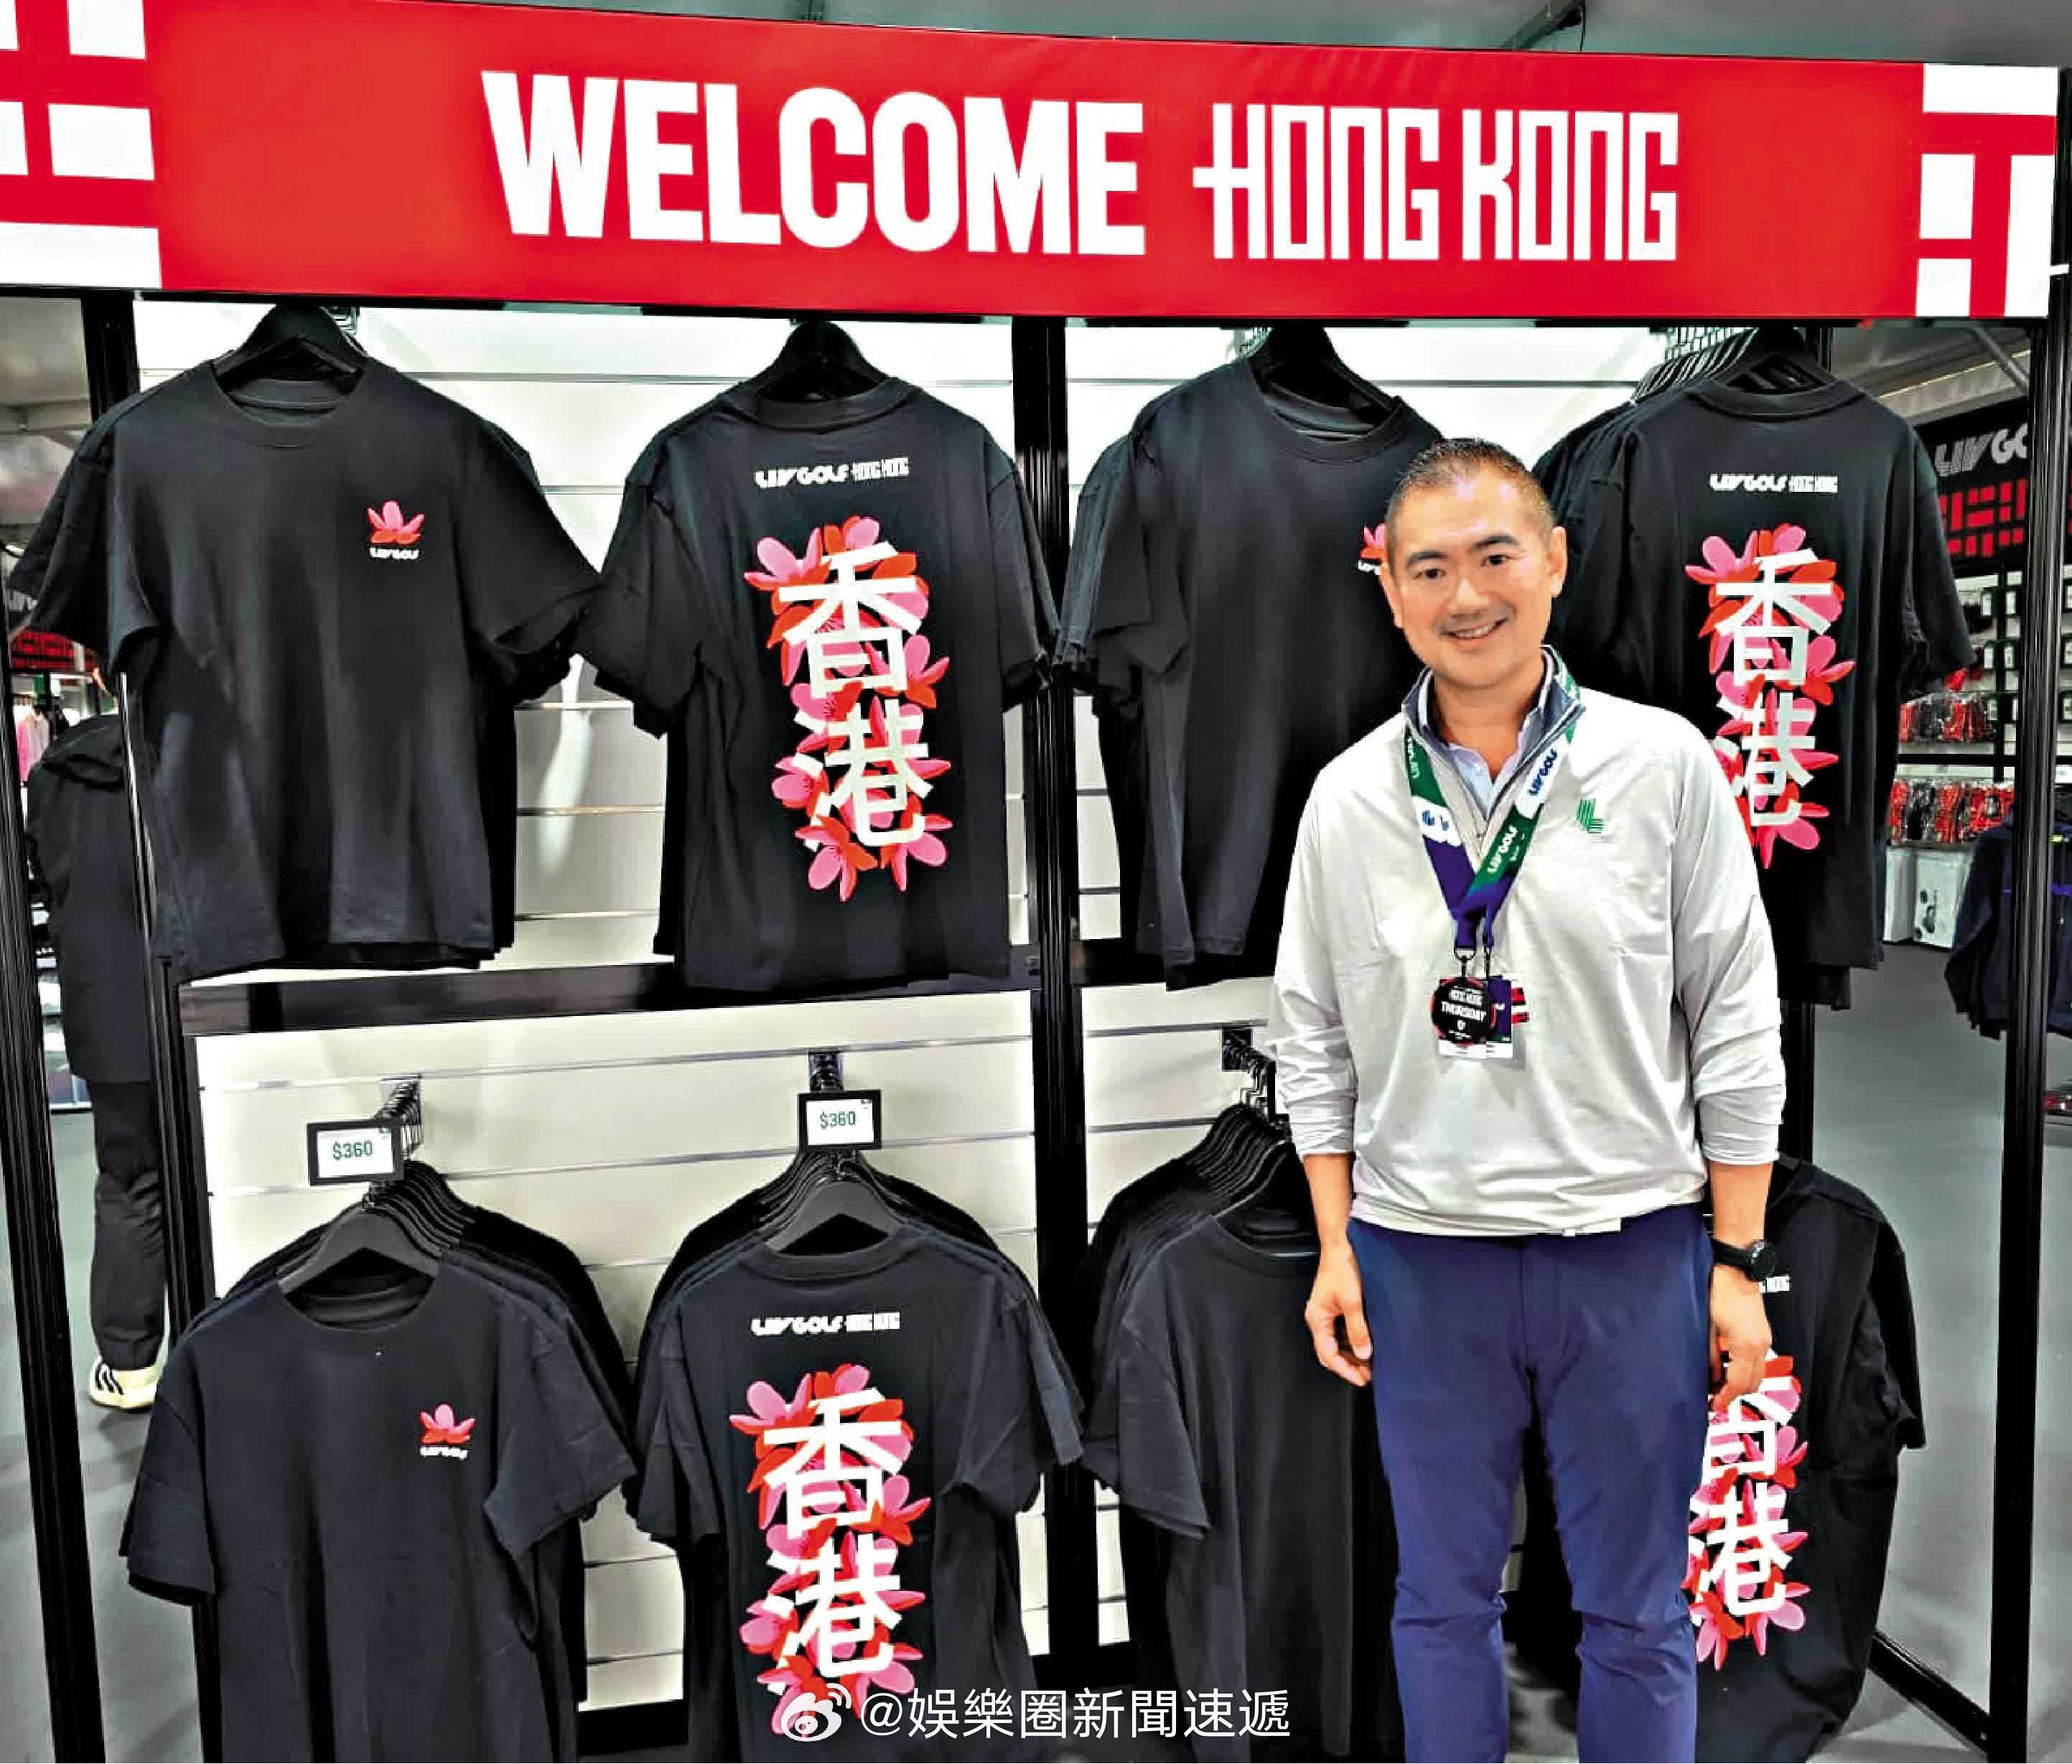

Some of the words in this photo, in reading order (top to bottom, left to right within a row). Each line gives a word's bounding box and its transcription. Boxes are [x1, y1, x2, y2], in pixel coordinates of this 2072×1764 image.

[481, 70, 1147, 256] WELCOME
[1193, 103, 1439, 260] HONG
[1462, 108, 1679, 261] KONG
[778, 540, 933, 852] 香港
[1713, 548, 1832, 827] 香港
[332, 1139, 374, 1161] $360
[819, 1110, 857, 1130] $360
[763, 1387, 902, 1697] 香港
[1689, 1348, 1793, 1626] 香港
